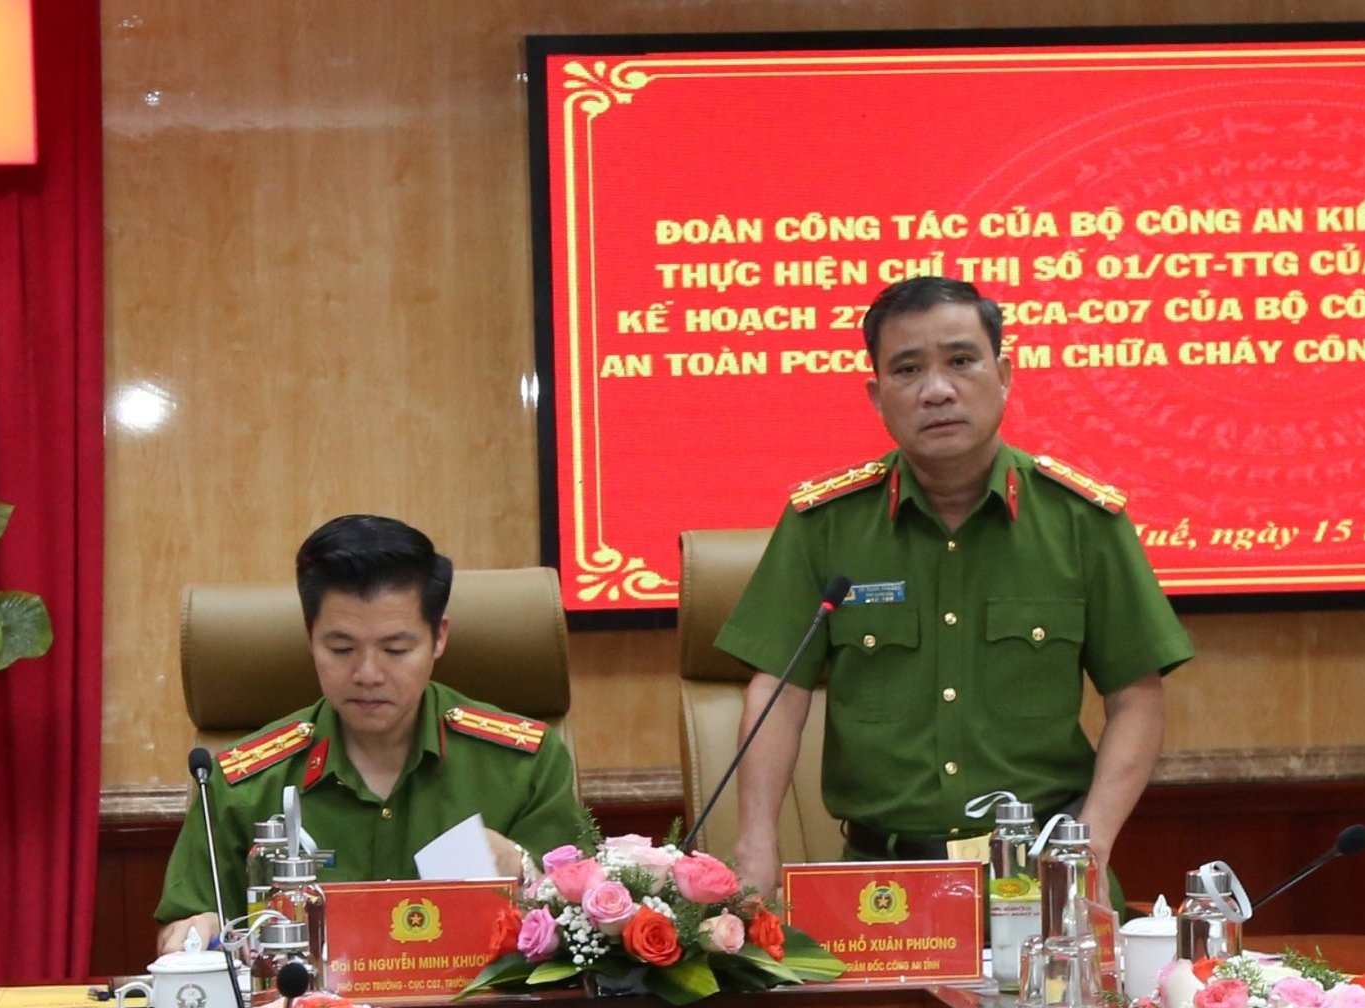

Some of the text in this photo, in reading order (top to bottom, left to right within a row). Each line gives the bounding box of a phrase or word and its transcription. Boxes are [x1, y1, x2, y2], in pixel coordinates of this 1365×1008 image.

[655, 214, 763, 245] ĐOÀN
[774, 211, 881, 242] CÔNG
[891, 209, 969, 241] TÁC
[978, 205, 1060, 239] CỦA
[1070, 206, 1125, 241] BỘ
[1135, 204, 1242, 236] CÔNG
[1252, 207, 1304, 234] AN
[655, 259, 761, 293] THỰC
[773, 255, 868, 291] HIỆN
[878, 250, 945, 278] CHỈ
[955, 256, 1020, 287] THỊ
[1032, 248, 1086, 282] SỐ
[1096, 250, 1299, 280] 01/CT-TTG
[617, 300, 674, 334] KẾ
[685, 305, 817, 336] HOẠCH
[1164, 289, 1244, 323] CỦA
[1255, 289, 1309, 325] BỘ
[599, 354, 653, 378] AN
[663, 347, 768, 377] TOÀN
[1061, 337, 1169, 368] CHỮA
[1178, 335, 1283, 366] CHÁY
[1134, 518, 1197, 550] uế,
[1210, 521, 1300, 551] ngày
[1313, 519, 1353, 543] 15
[368, 952, 416, 971] NGUYỄN
[418, 956, 450, 969] MINH
[833, 938, 846, 953] tá
[870, 936, 903, 952] XUÂN
[906, 936, 958, 951] PHƯƠNG
